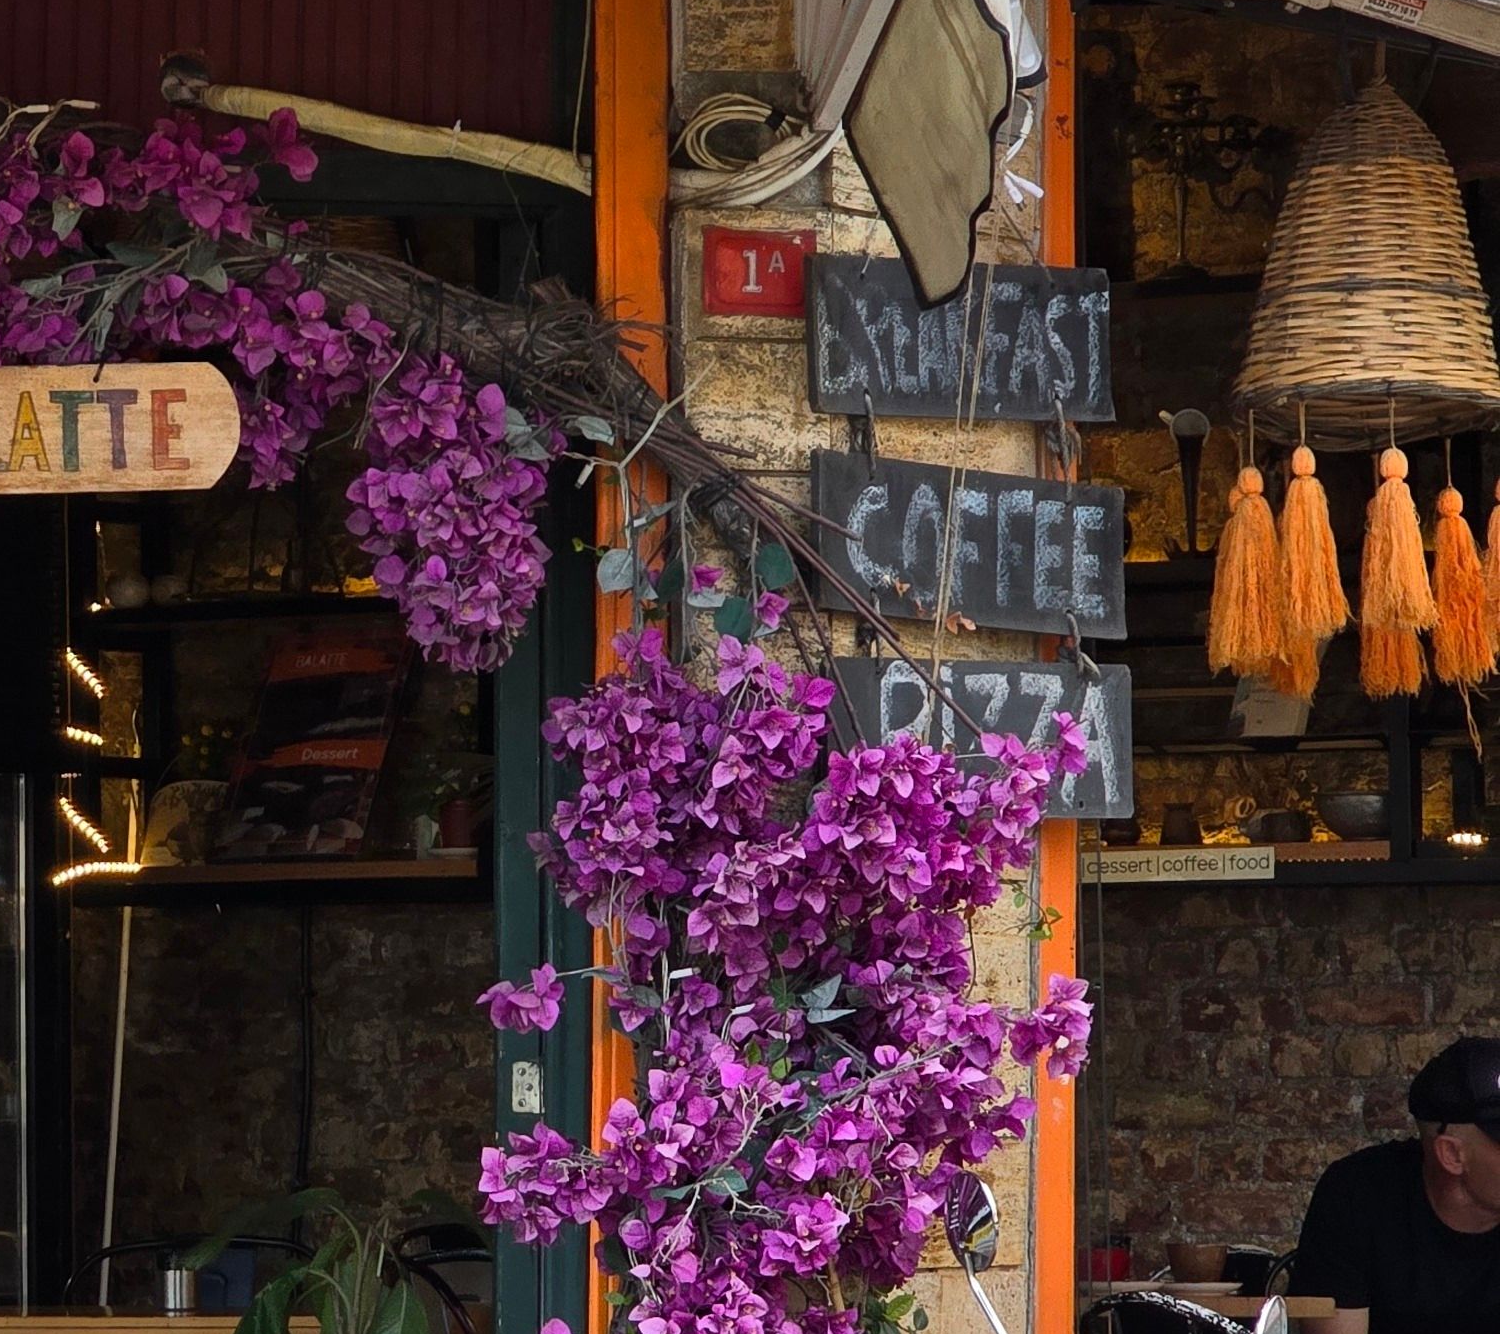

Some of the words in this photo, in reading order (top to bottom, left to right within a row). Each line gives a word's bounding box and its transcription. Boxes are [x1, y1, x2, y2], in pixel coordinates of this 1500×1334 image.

[846, 483, 1105, 619] COFFEE
[301, 747, 359, 762] Dessert
[1161, 854, 1219, 873] coffee
[1229, 853, 1271, 872] food
